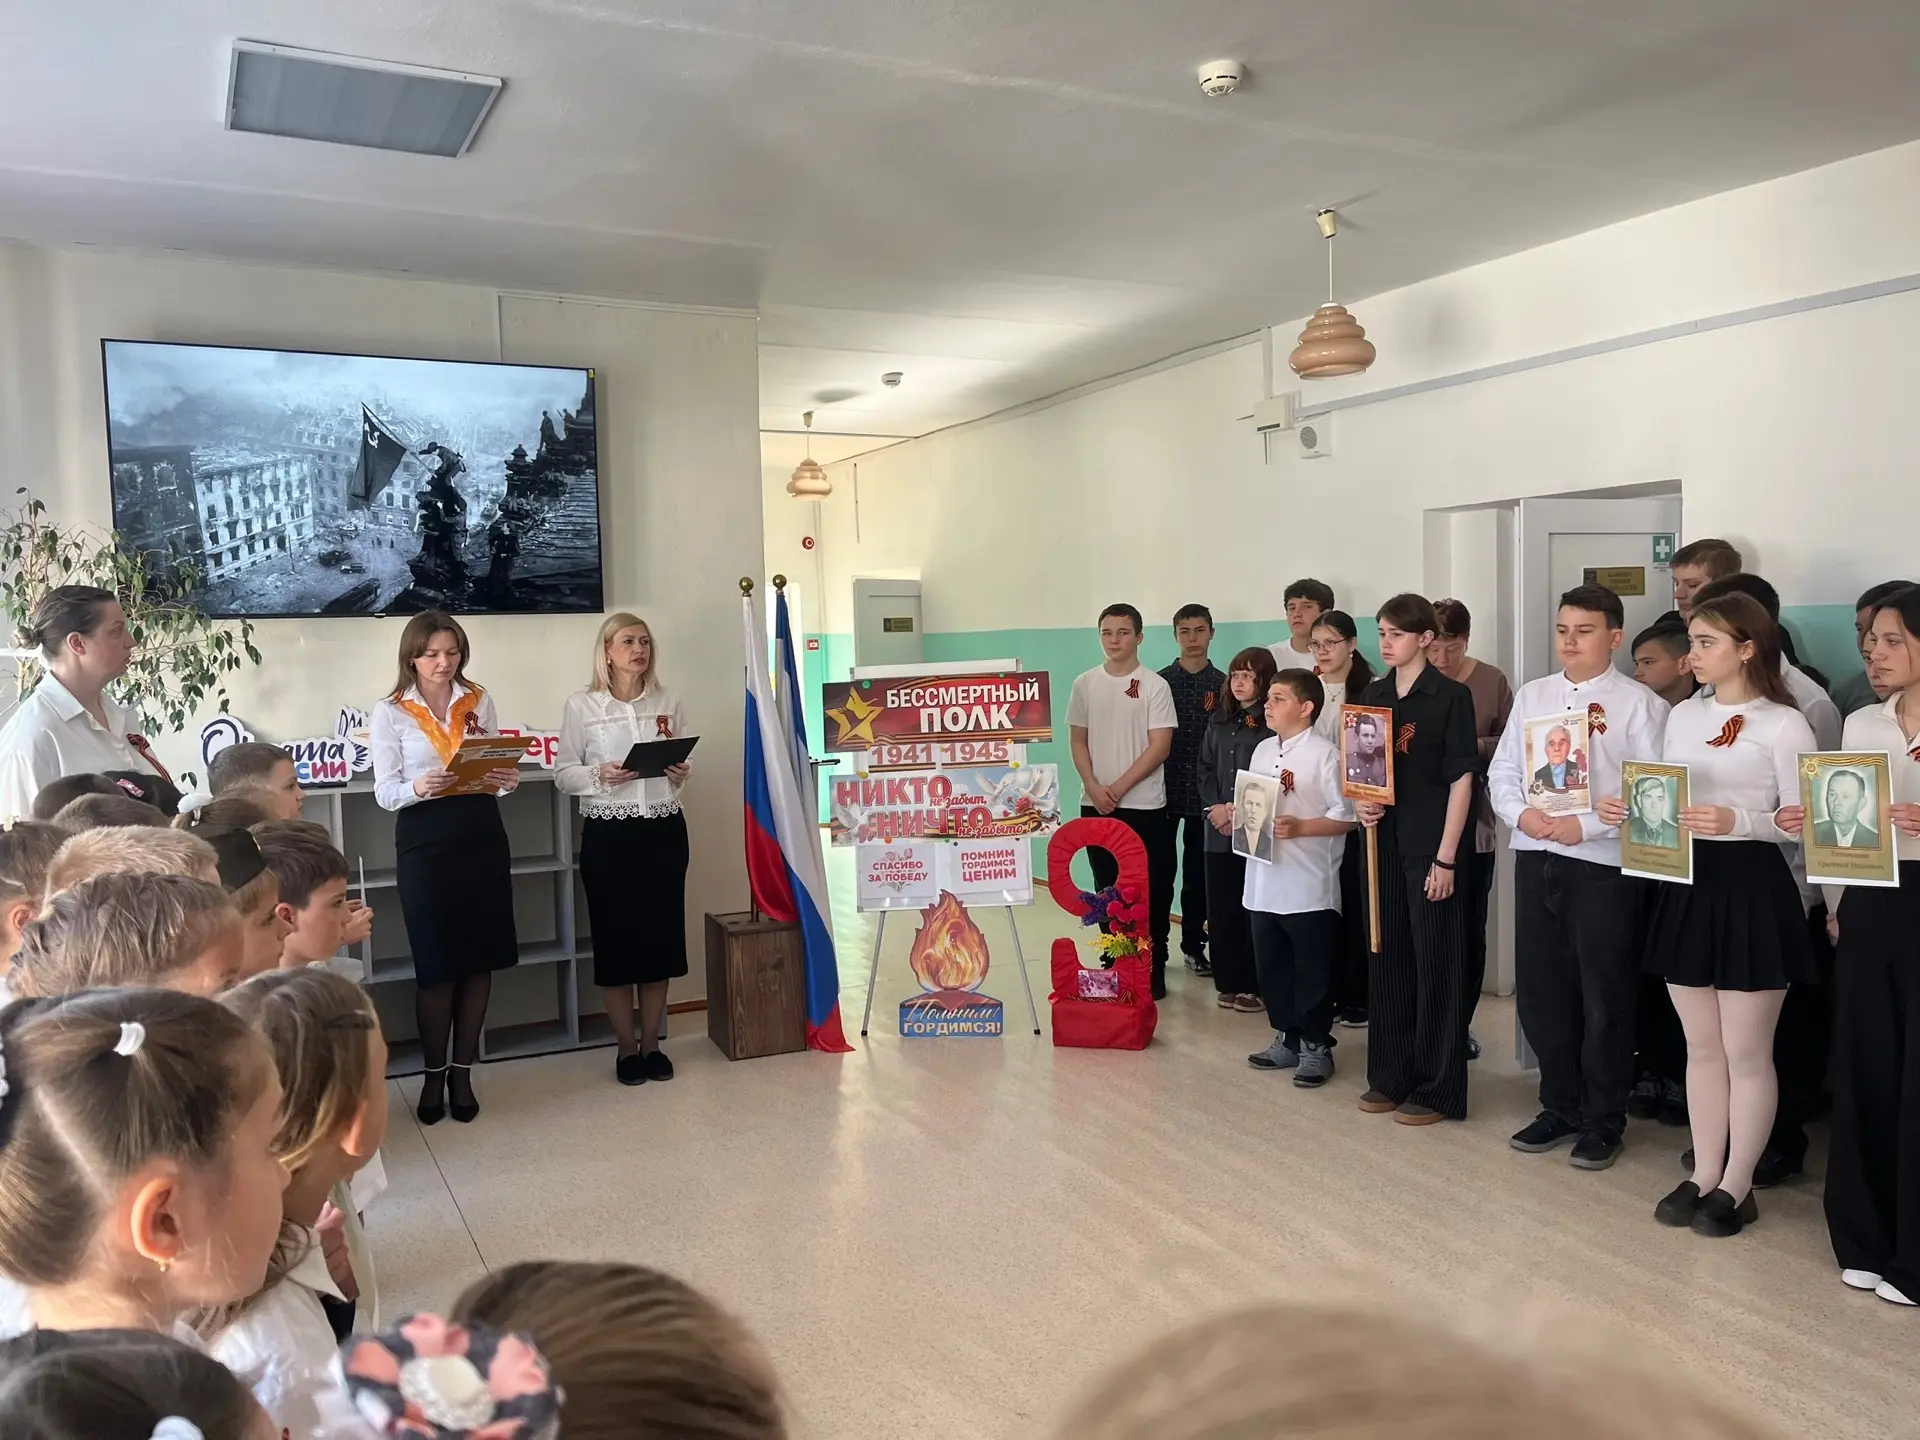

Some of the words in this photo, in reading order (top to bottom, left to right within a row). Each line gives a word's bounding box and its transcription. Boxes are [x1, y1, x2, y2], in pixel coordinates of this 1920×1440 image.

[886, 677, 1040, 708] БЕССМЕРТНЫЙ
[920, 703, 1014, 733] ПОЛК
[871, 743, 933, 765] 1941
[942, 741, 1009, 762] 1945
[837, 775, 953, 807] НИКТО
[929, 796, 946, 806] не
[876, 805, 993, 838] НИЧТО
[958, 826, 975, 836] не
[961, 849, 1016, 862] ПОМНИМ
[872, 860, 924, 871] СПАСИБО
[961, 858, 1017, 870] ГОРДИМСЯ
[867, 873, 882, 883] ЗА
[885, 871, 929, 882] ПОБЕДУ
[962, 868, 1018, 883] ЦЕНИМ
[903, 1022, 1001, 1036] ГОРДИМСЯ!
